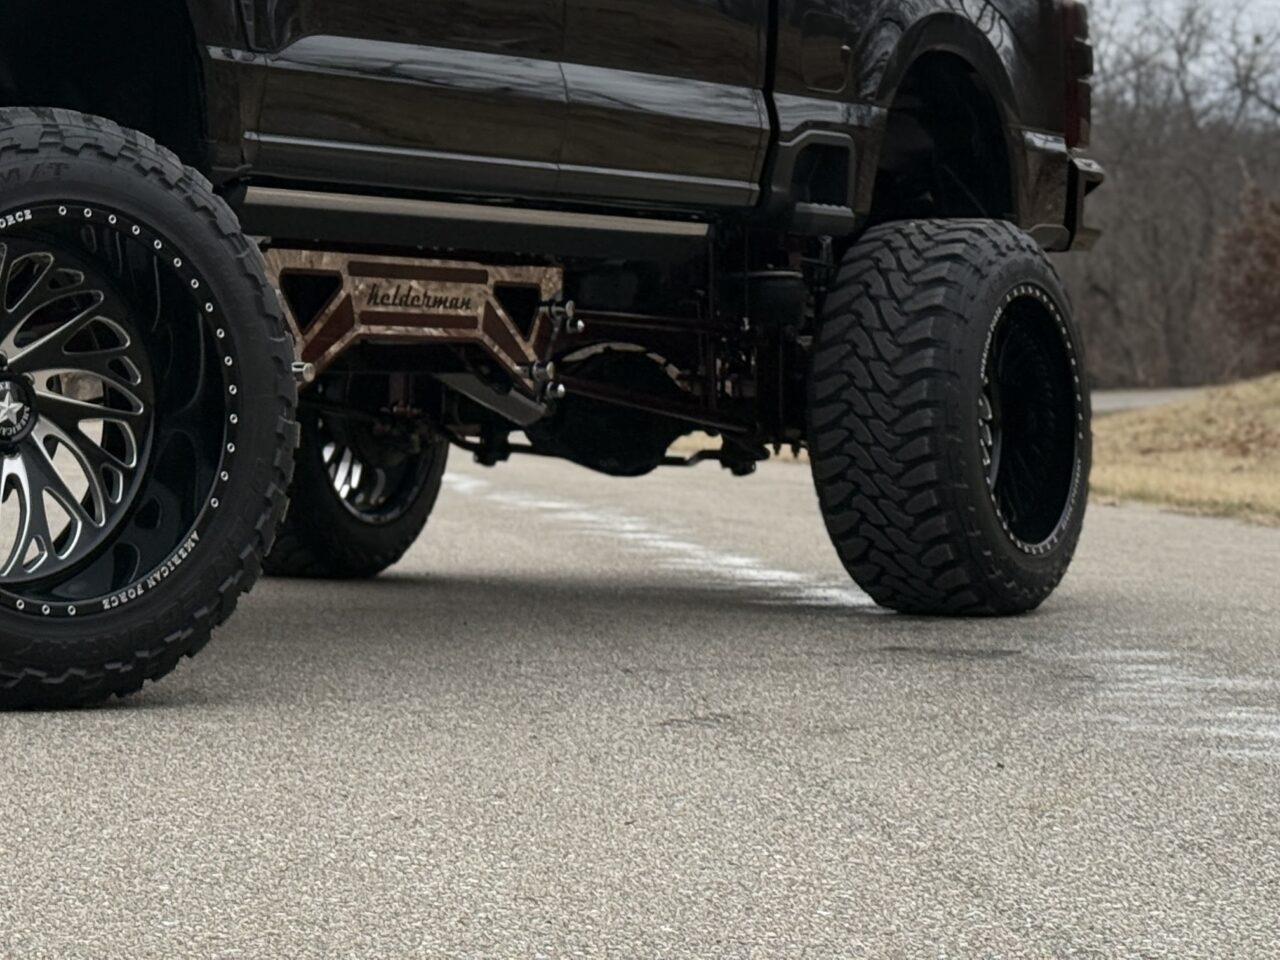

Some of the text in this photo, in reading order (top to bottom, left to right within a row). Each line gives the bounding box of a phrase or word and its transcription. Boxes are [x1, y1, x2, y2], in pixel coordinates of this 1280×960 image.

[367, 283, 472, 311] kelderman
[145, 530, 200, 588] AMERICAN
[102, 583, 145, 610] FORCE
